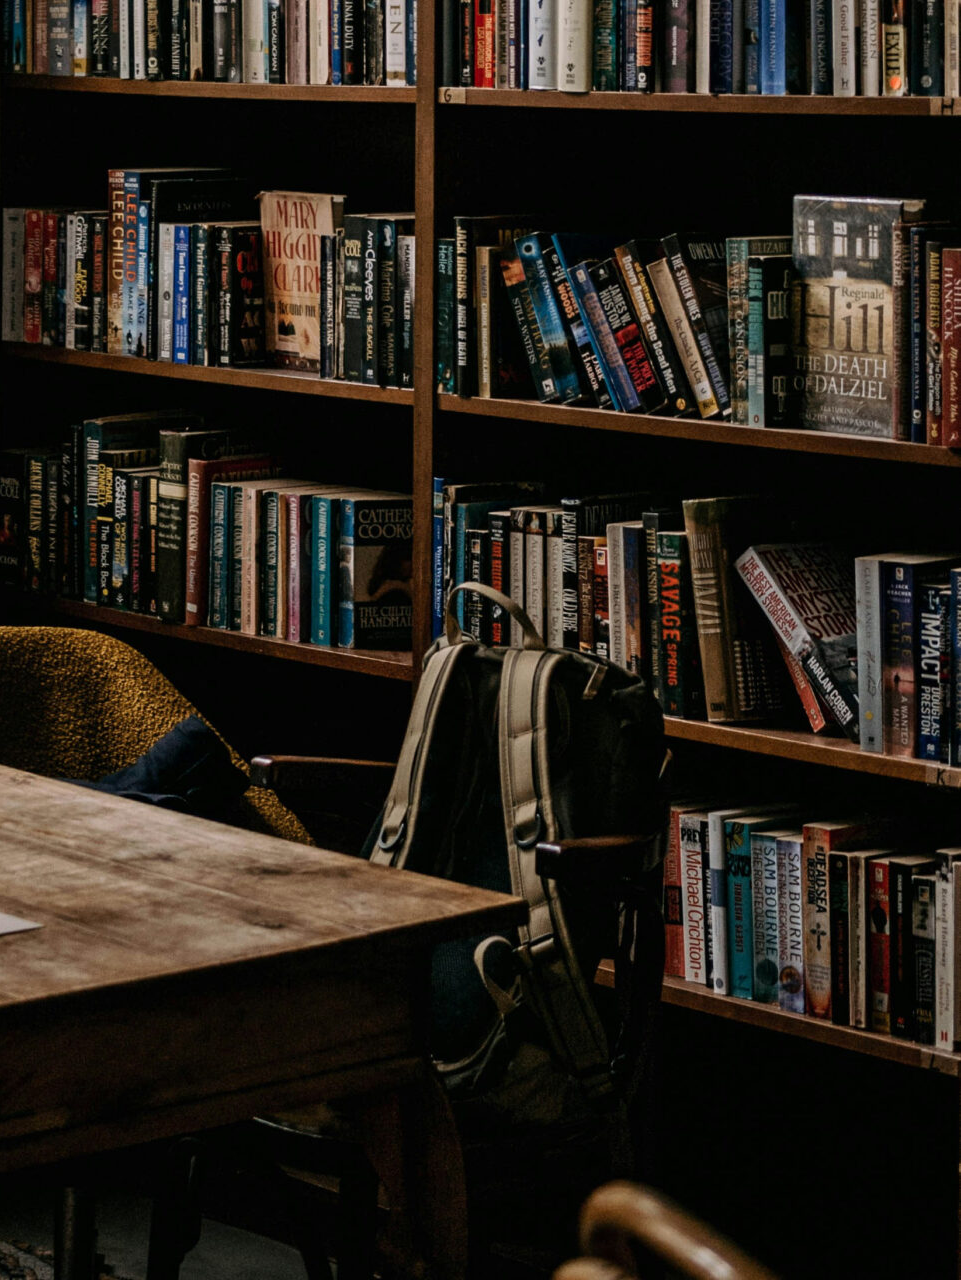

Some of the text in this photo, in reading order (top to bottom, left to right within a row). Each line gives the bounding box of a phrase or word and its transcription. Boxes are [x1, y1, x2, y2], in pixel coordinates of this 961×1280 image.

[344, 25, 354, 50] DUTY
[885, 31, 900, 76] EXILE
[443, 90, 453, 104] G
[941, 98, 955, 116] H
[125, 193, 137, 225] LEE
[276, 199, 319, 230] MARY
[76, 215, 85, 259] Cornwell
[112, 190, 125, 280] LEE CHILD
[125, 228, 138, 282] CHILD
[367, 230, 375, 249] Ann
[137, 223, 148, 324] James Patterson FANG
[365, 249, 376, 301] Cleeves
[456, 226, 467, 367] JACK HIGGINS ANGEL OF DEATH
[670, 253, 700, 322] THE STOLEN ONES
[841, 286, 885, 303] Reginald
[929, 251, 940, 329] ADAM ROBERTS
[127, 313, 134, 326] ME
[403, 289, 411, 320] HELLER
[599, 288, 622, 330] HUSTON
[622, 255, 678, 395] Down Among the Dead Men
[749, 266, 763, 351] JACK HIGGINS
[792, 282, 886, 355] Hill
[944, 266, 954, 341] HANCOCK
[624, 356, 646, 394] POWER
[632, 341, 656, 389] THE PRICE
[792, 374, 887, 401] OF DALZIEL
[793, 354, 888, 379] THE DEATH
[86, 436, 99, 460] JOHN
[29, 459, 43, 532] JACKIE COLLINS
[86, 463, 99, 508] CONNOLLY
[98, 463, 106, 508] CONNELLY
[105, 465, 113, 504] MICHAEL
[114, 475, 122, 519] CONNELLY
[358, 508, 412, 524] CATHER
[89, 539, 97, 567] LOVERS
[100, 525, 110, 588] The Black Box
[646, 527, 658, 605] THE PASSION
[359, 605, 379, 618] THE
[562, 542, 577, 633] KOONTZ COLD FIRE
[739, 562, 793, 642] MYSTERY STORIES 2011
[744, 555, 798, 632] THE BEST AMERICAN
[659, 562, 681, 687] SAVAGE SPRING
[901, 621, 912, 658] LEE
[920, 612, 940, 683] IMPACT
[806, 655, 854, 725] HARLAN COBEN
[920, 685, 931, 736] PRESTON
[930, 685, 941, 737] DOUGLAS
[936, 768, 946, 785] K
[680, 827, 705, 843] PREY
[754, 846, 763, 955] THE RIGHTEOUS MEN
[764, 846, 778, 956] SAM BOURNE
[807, 857, 816, 906] DECEPTION
[815, 852, 827, 913] DEAD SEA
[685, 849, 703, 970] Michael Crichton
[788, 852, 801, 962] SAM BOURNE
